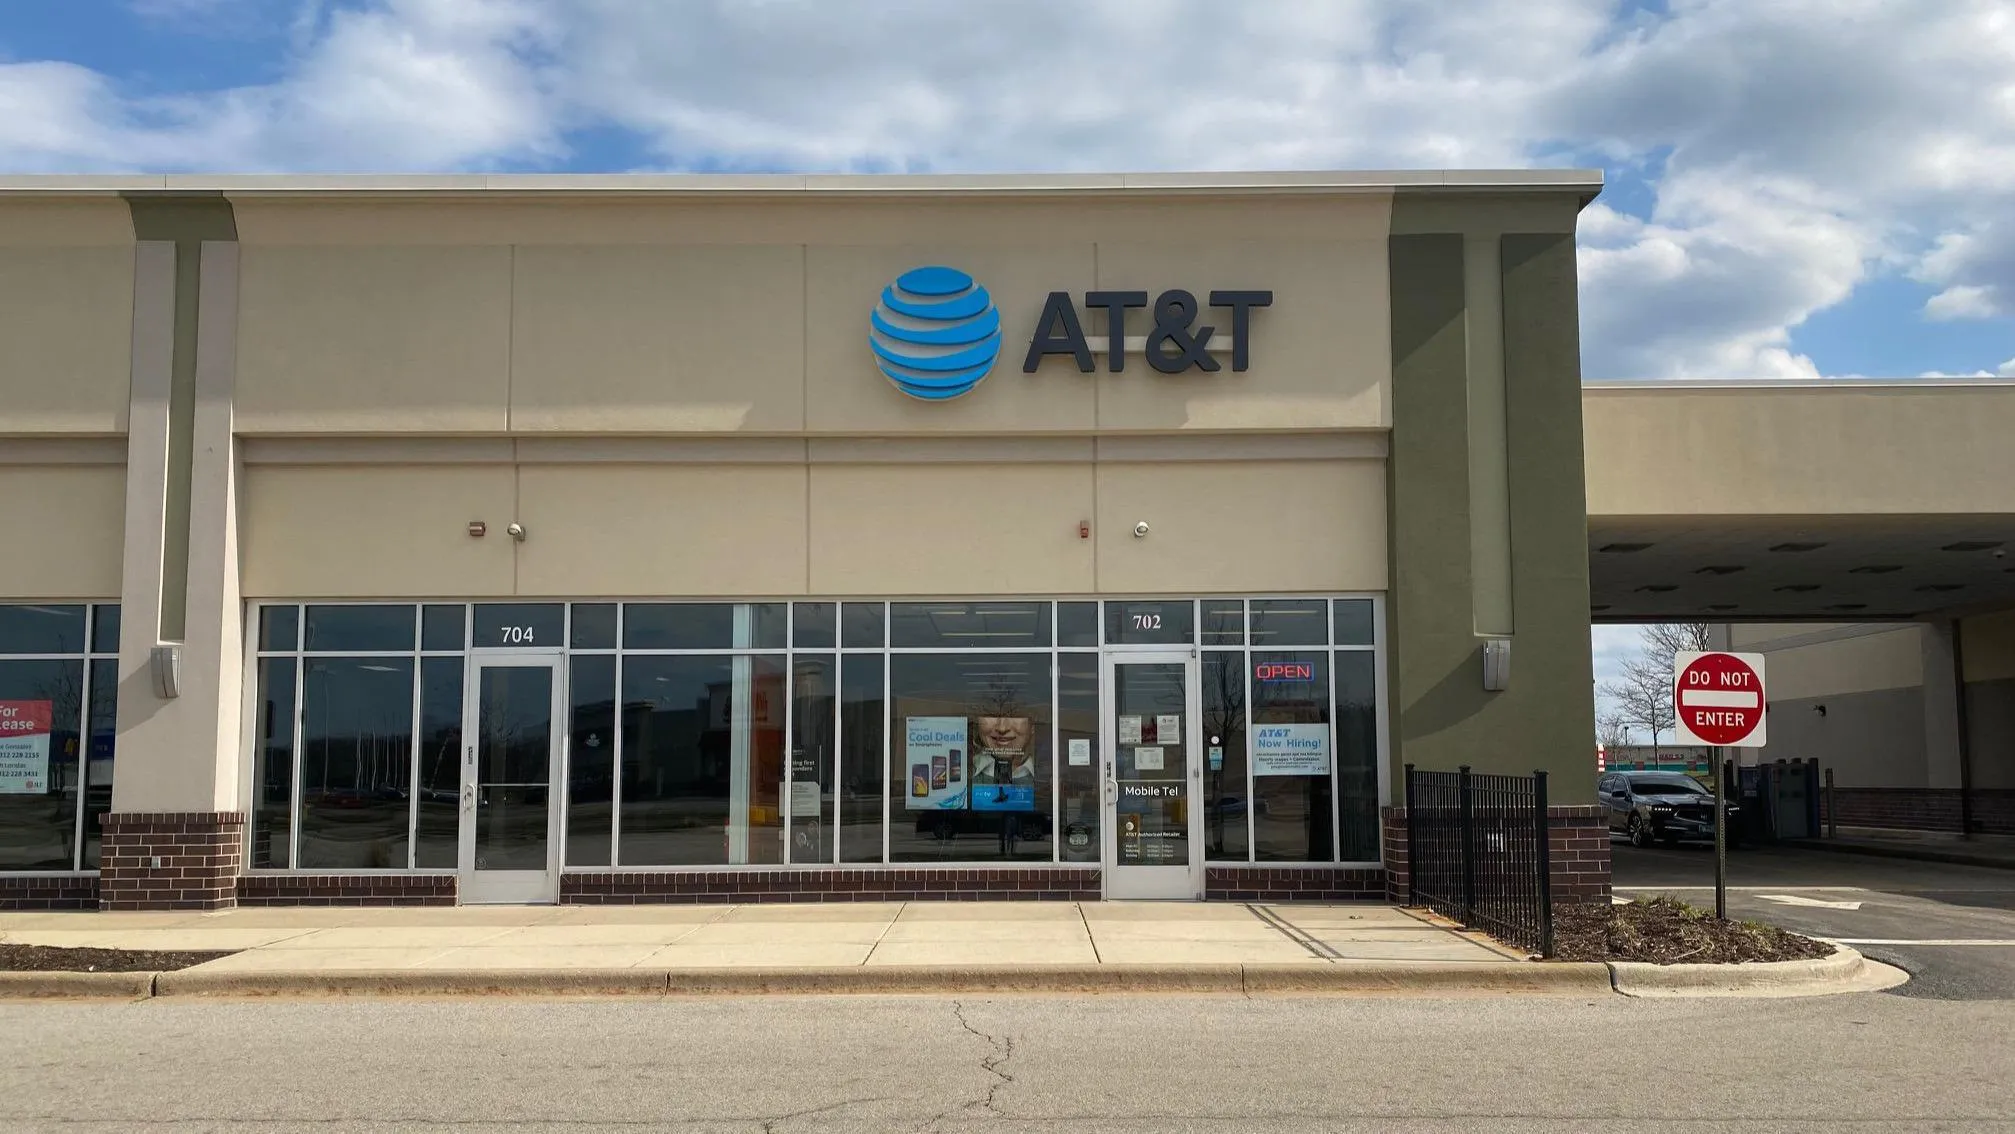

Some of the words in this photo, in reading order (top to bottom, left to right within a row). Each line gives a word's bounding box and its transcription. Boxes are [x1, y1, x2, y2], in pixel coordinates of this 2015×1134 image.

[1023, 288, 1273, 374] AT&T
[1132, 615, 1161, 629] 702
[501, 626, 534, 643] 704
[1257, 664, 1310, 679] OPEN
[1689, 671, 1710, 685] DO
[1720, 672, 1750, 687] NOT
[0, 719, 35, 730] ease
[1696, 711, 1745, 727] ENTER
[909, 731, 933, 742] Cool
[935, 731, 964, 742] Deals
[1259, 728, 1291, 738] AT&T
[1258, 738, 1282, 748] Now
[1287, 738, 1321, 750] Hiring!
[1125, 786, 1160, 796] Mobile
[1162, 786, 1178, 796] Tel
